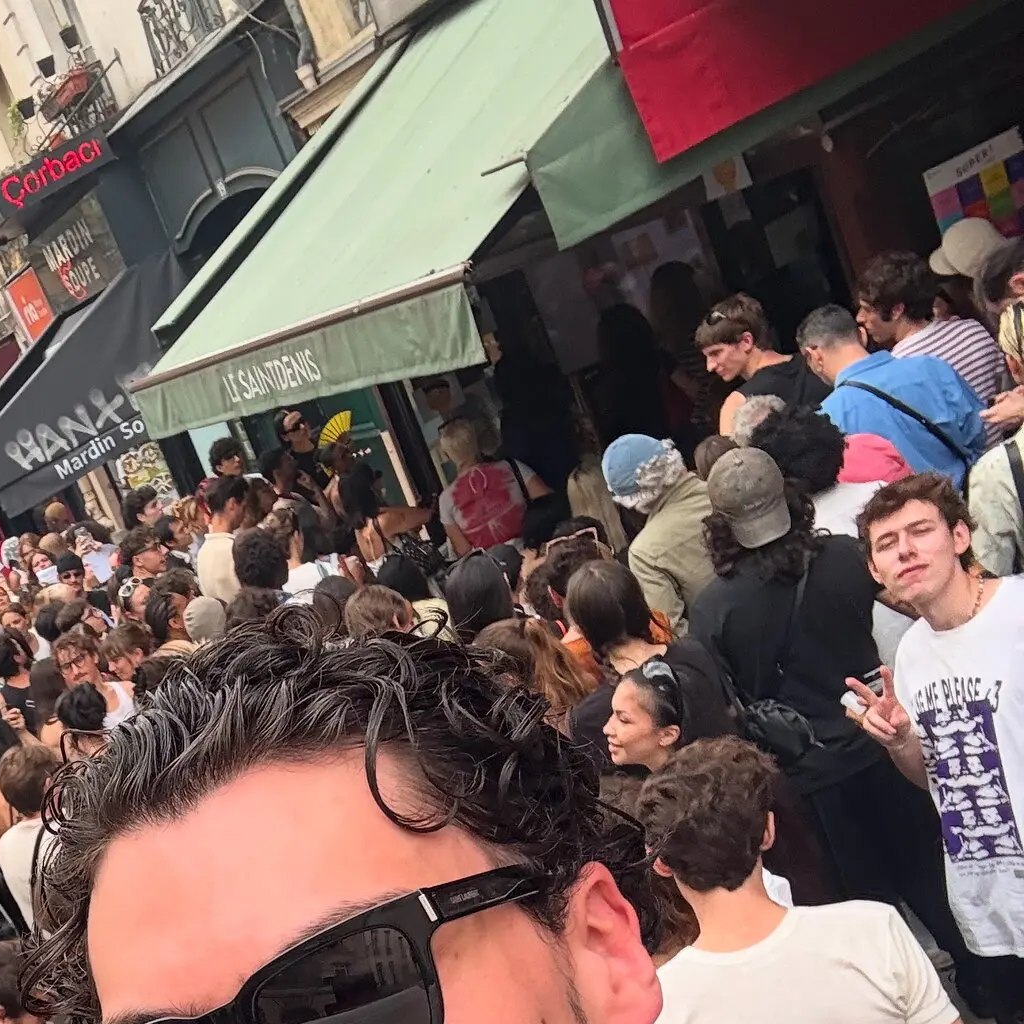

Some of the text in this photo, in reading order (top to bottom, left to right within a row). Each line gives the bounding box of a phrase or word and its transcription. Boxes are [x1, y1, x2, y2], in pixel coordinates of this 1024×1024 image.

[42, 217, 94, 273] MARDIN
[54, 435, 116, 479] Mardin
[941, 676, 982, 711] PLEASE
